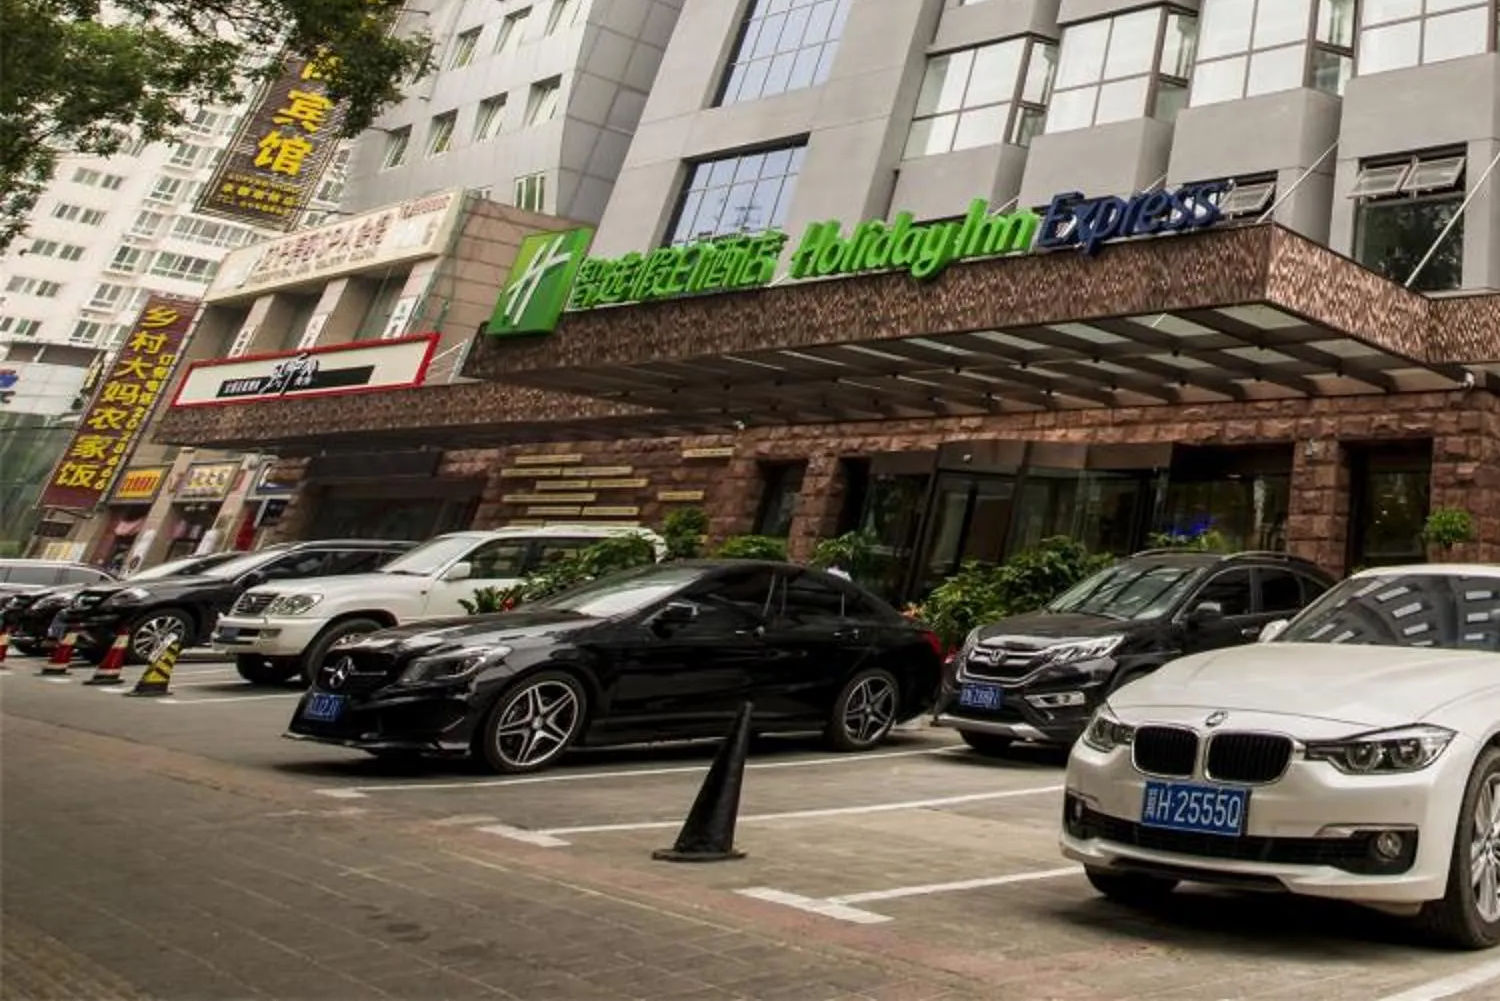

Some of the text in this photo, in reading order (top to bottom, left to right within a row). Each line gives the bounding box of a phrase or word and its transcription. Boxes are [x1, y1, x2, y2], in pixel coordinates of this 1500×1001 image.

[789, 184, 1230, 280] Holiday Inn Express
[56, 305, 179, 488] 乡村大妈农家饭
